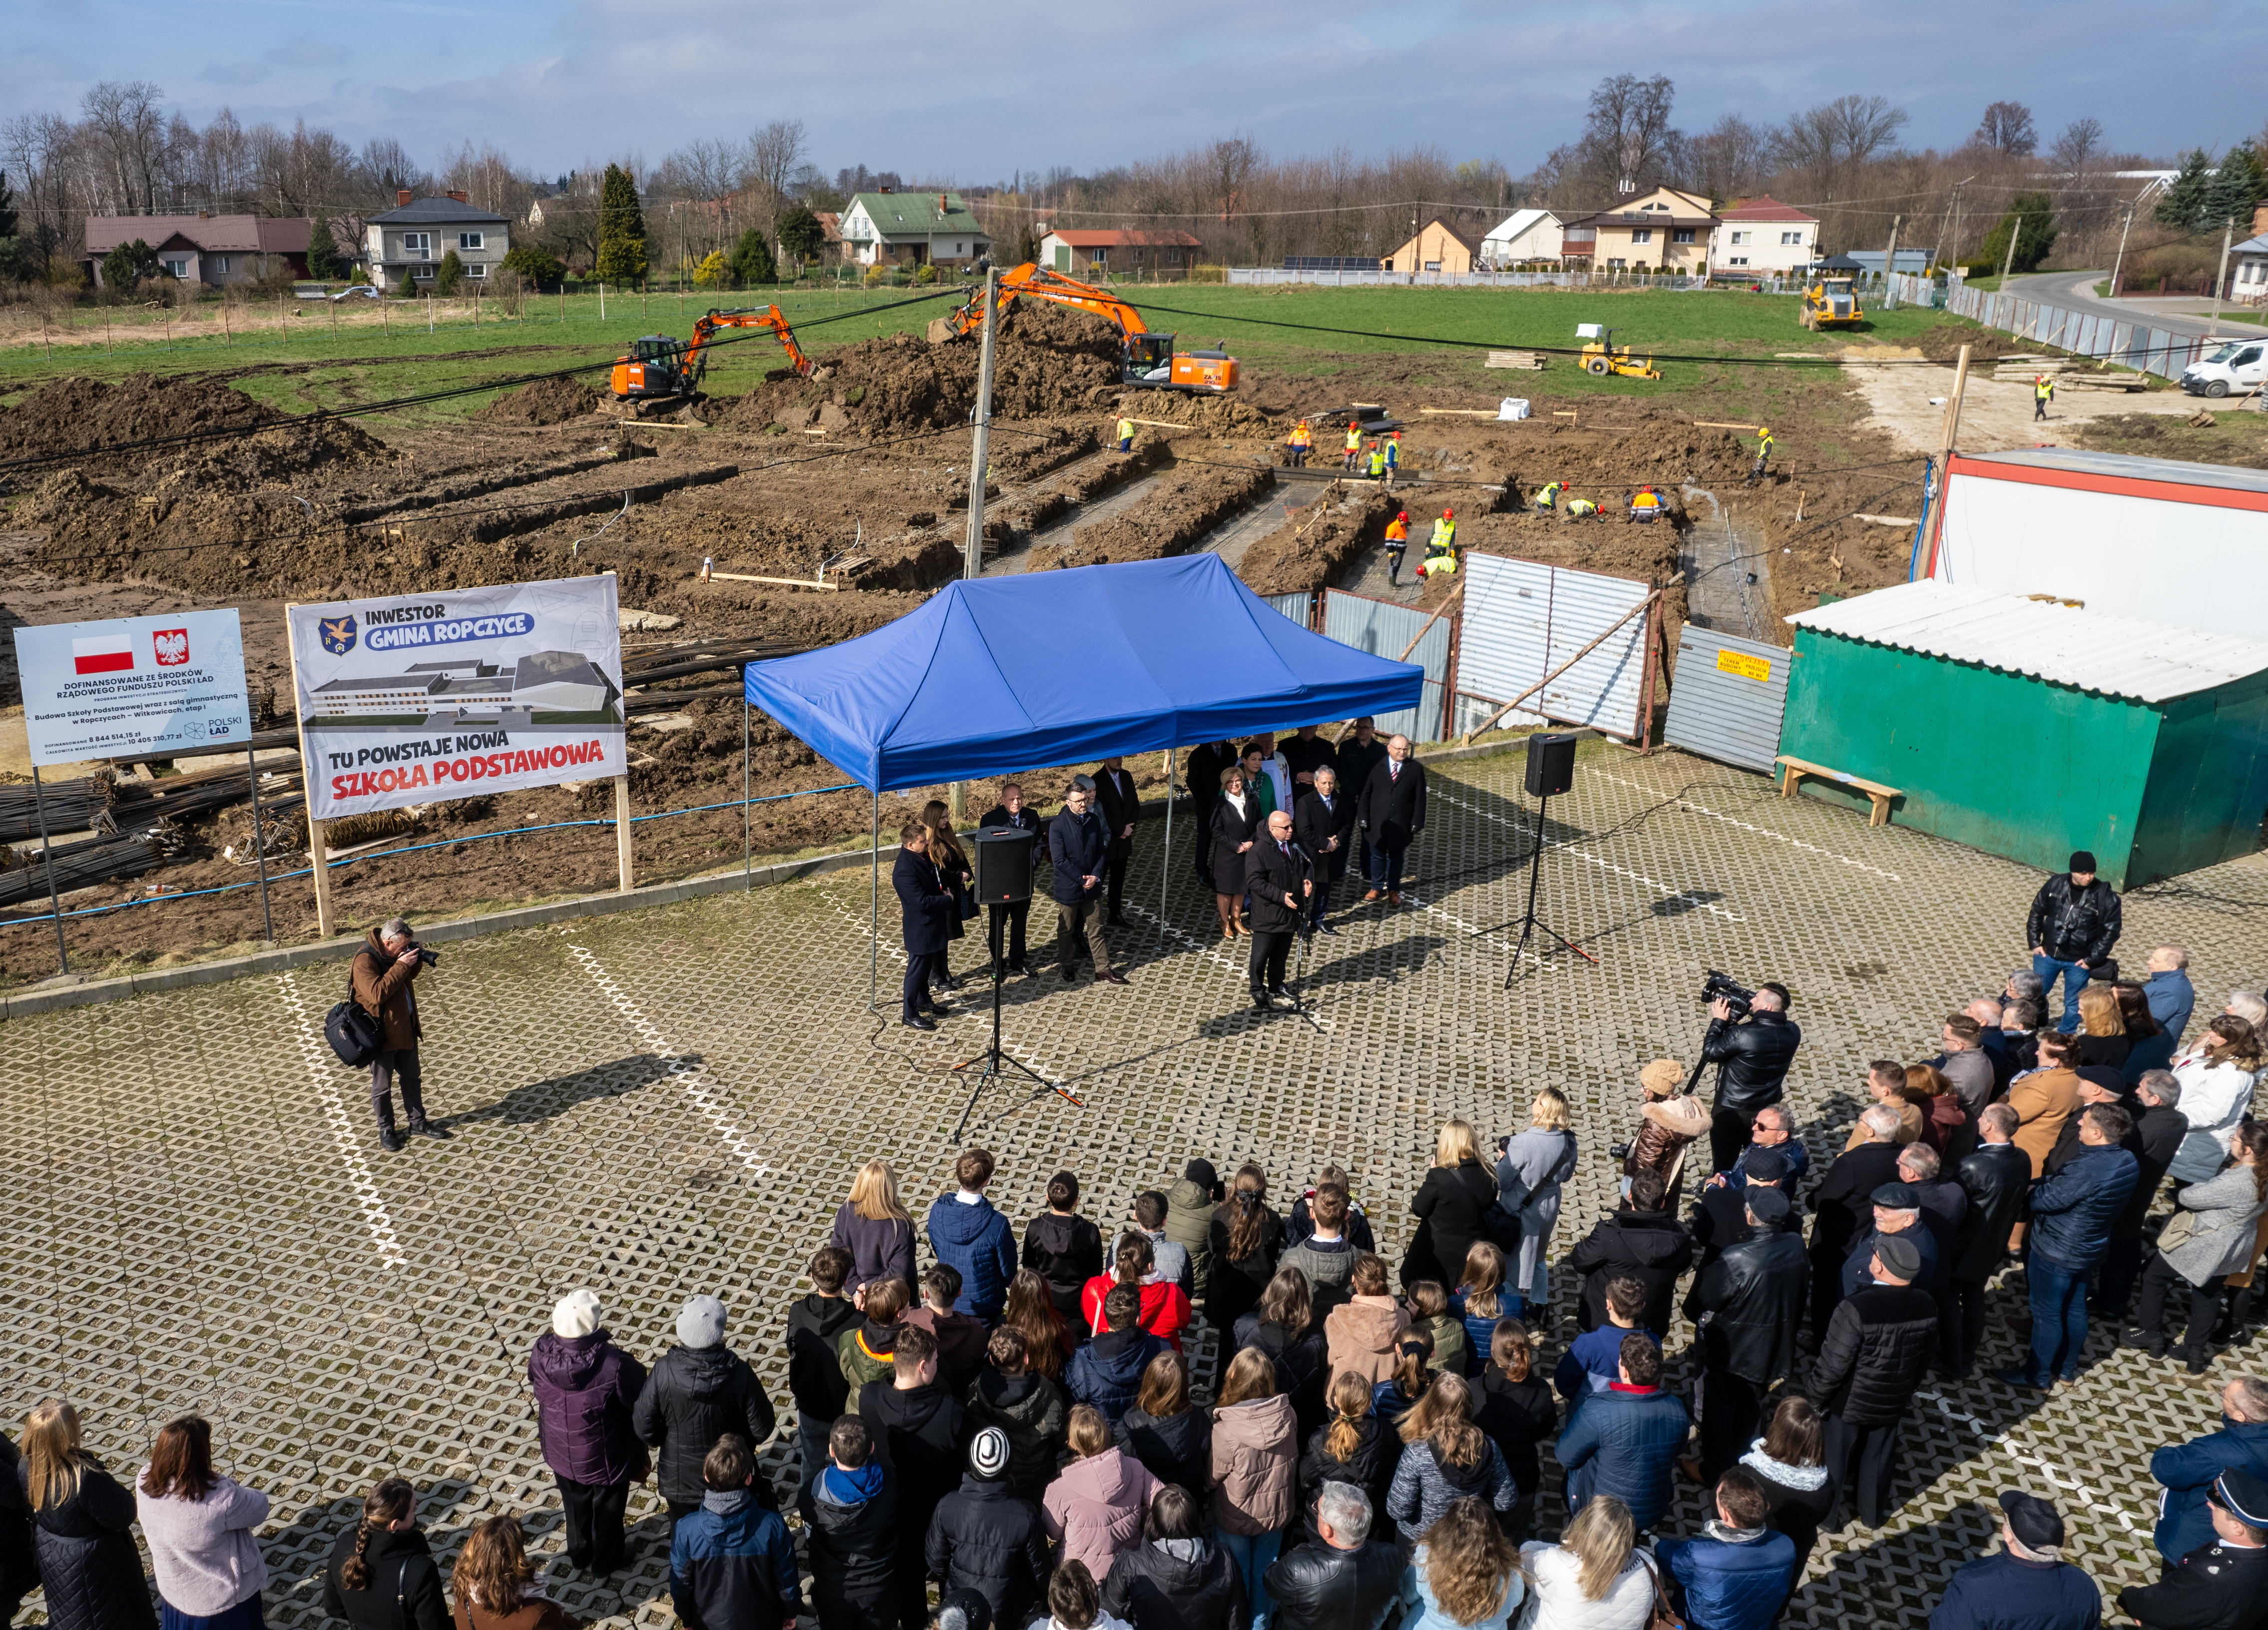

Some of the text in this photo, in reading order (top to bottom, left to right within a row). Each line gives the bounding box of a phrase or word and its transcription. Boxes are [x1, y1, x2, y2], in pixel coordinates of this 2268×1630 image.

[366, 604, 445, 625] INWESTOR
[370, 614, 526, 648] GMINA ROPCZYCE
[57, 687, 115, 699] RZĄDOWEGO
[117, 682, 163, 692] FUNDUSZU
[166, 678, 195, 687] POLSKI
[64, 676, 144, 690] DOFINANSOWANE
[158, 669, 202, 680] ŚRODKÓW
[35, 712, 66, 720] Budowa
[93, 703, 143, 714] Podstawowej
[186, 694, 238, 704] gimnastyczną
[80, 714, 126, 724] Ropczycach
[134, 707, 184, 717] Witkowicach,
[209, 716, 242, 727] POLSKI
[210, 726, 229, 735] ŁAD
[328, 729, 509, 769] TU POWSTAJE NOWA
[332, 739, 604, 800] SZKOŁA PODSTAWOWA
